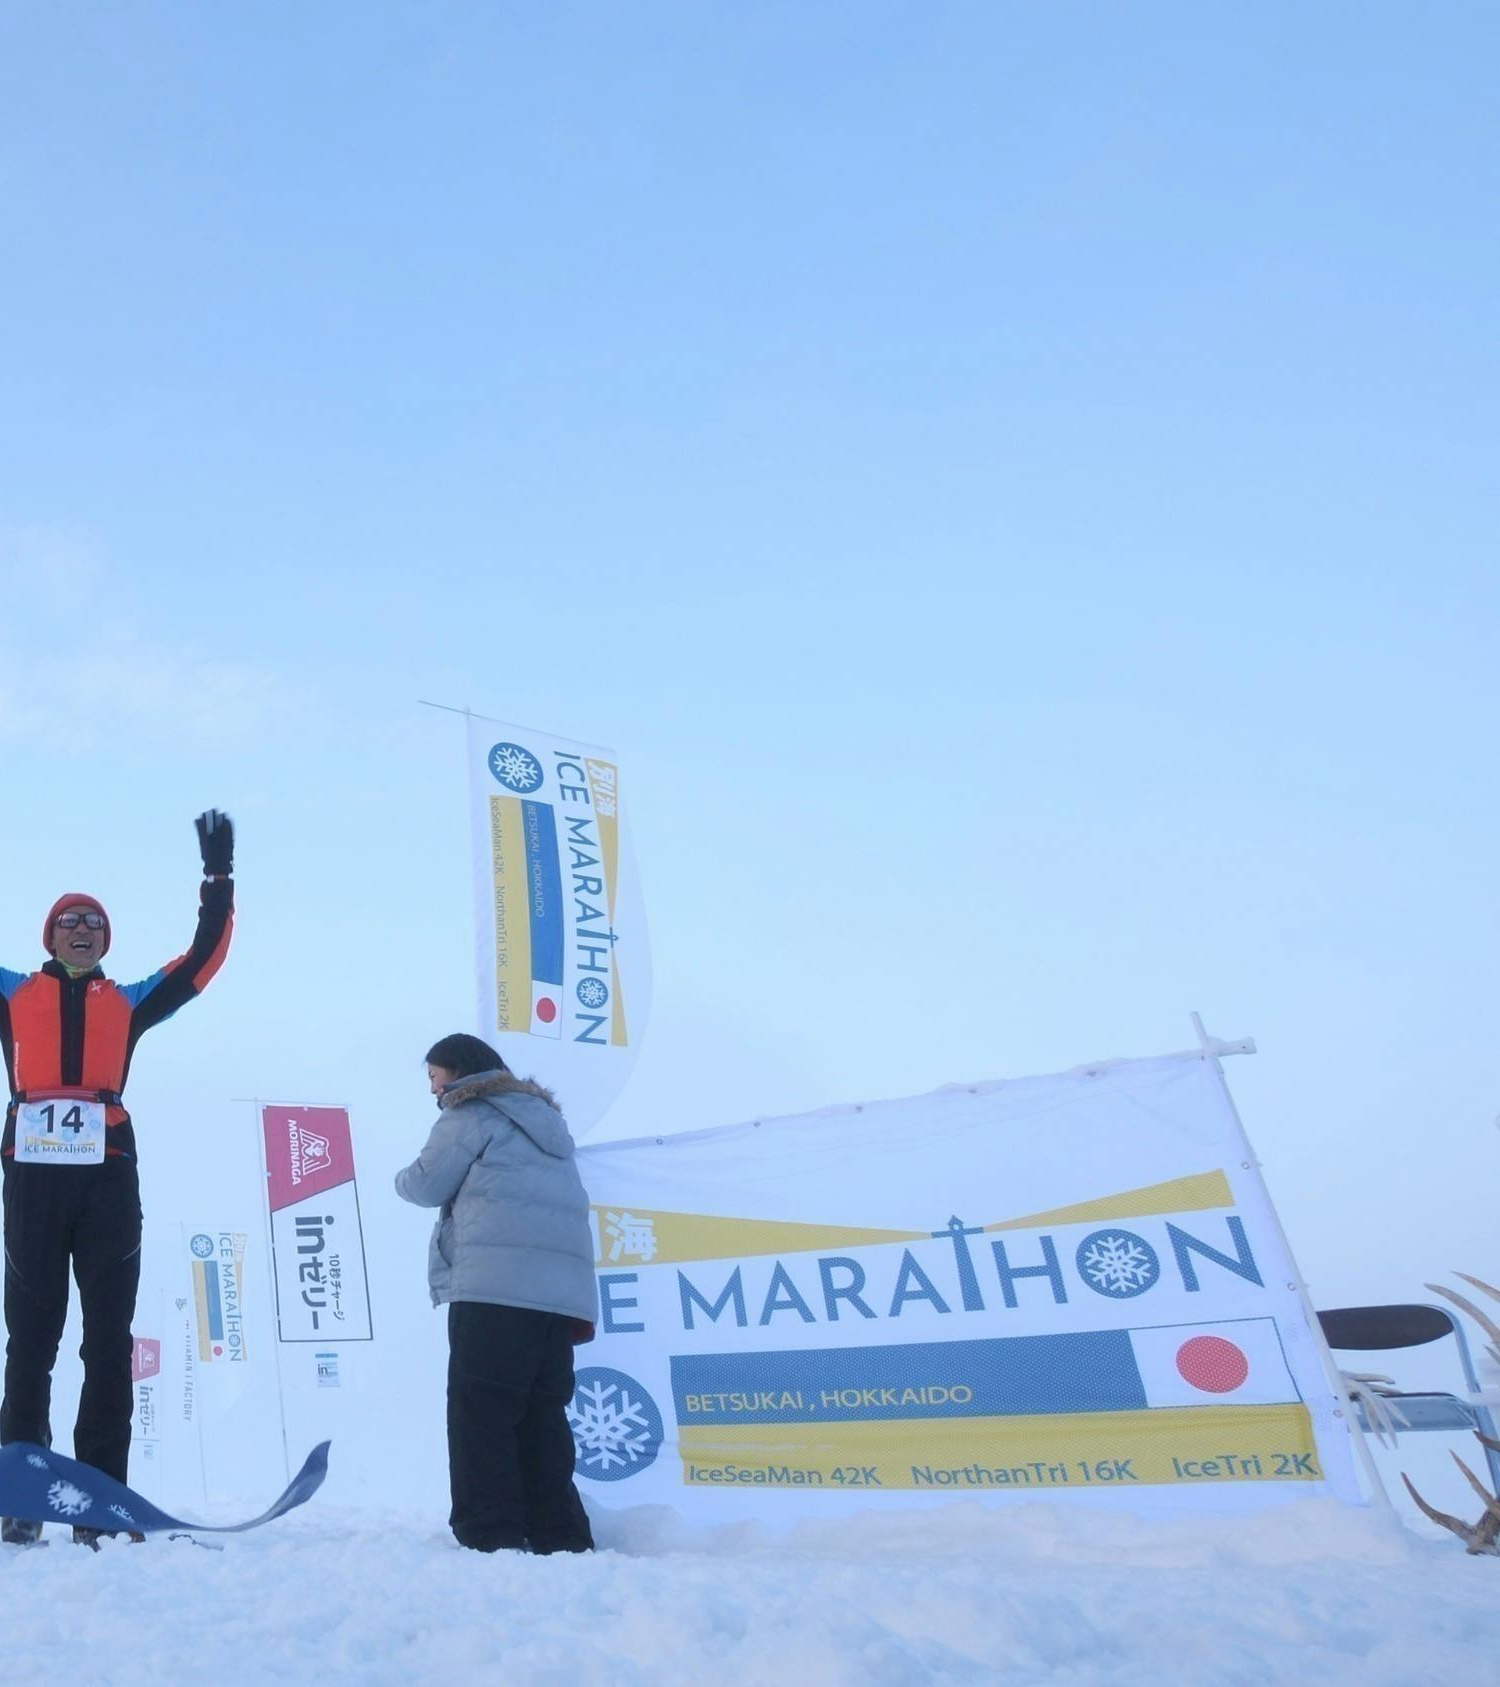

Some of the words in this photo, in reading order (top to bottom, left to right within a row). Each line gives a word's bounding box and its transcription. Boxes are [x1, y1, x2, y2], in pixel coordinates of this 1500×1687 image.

[553, 751, 590, 804] ICE
[564, 815, 619, 1046] MARATHON
[499, 1017, 509, 1031] 2K
[40, 1103, 85, 1134] 14
[24, 1145, 38, 1154] ICE
[288, 1119, 301, 1186] MORINAGA
[218, 1232, 233, 1257] ICE
[589, 1210, 658, 1264] 海
[677, 1214, 1266, 1331] MARATHON
[222, 1264, 242, 1361] MARATHON
[820, 1385, 974, 1408] HOKKAIDO
[689, 1464, 824, 1486] IceSeaMan
[830, 1466, 882, 1486] 42K
[910, 1462, 1069, 1486] NorthanTri
[1078, 1458, 1140, 1481] 16K
[1172, 1454, 1263, 1479] IceTri
[1270, 1452, 1319, 1477] 2K
